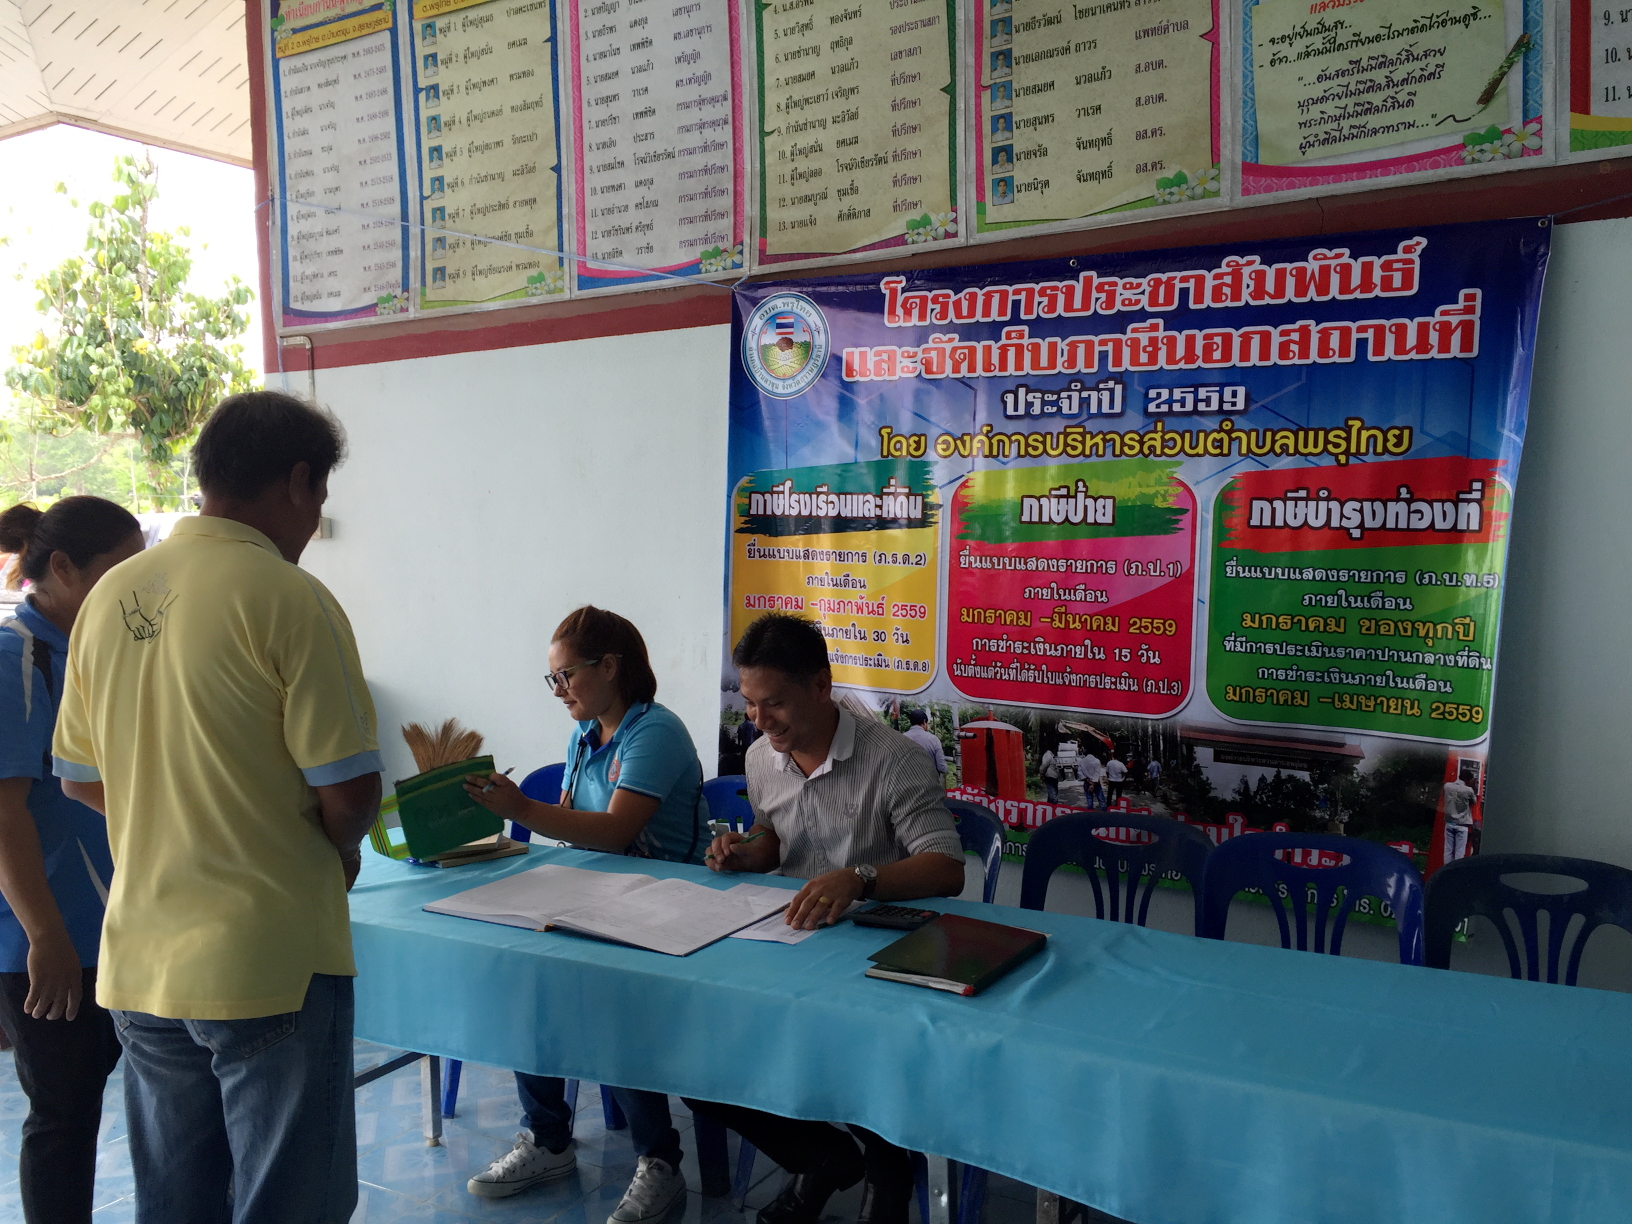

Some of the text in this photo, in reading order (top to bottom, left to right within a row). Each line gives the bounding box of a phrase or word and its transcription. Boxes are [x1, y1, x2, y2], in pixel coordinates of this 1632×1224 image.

[1604, 9, 1614, 26] 9.
[291, 41, 294, 49] 2
[774, 30, 781, 39] 5.
[775, 53, 781, 64] 6.
[1605, 47, 1621, 64] 10.
[776, 78, 782, 88] 7.
[1014, 80, 1055, 98] นายสมยศ
[1605, 86, 1621, 102] 11.
[776, 102, 783, 112] 8.
[778, 150, 787, 161] 10.
[461, 177, 464, 186] 6
[778, 174, 787, 185] 11.
[778, 197, 787, 208] 12.
[778, 221, 787, 232] 13.
[462, 270, 466, 279] 9
[881, 238, 1427, 327] โครงการประชาสัมพันธ์
[843, 289, 1481, 381] และจัดเก็บภาษีนอกสถานที่
[1003, 382, 1246, 416] ประจำปี 2559
[880, 420, 1410, 464] โดย องค์การบริหารส่วนตำบลพรุไทย
[750, 478, 924, 519] ภาษีโรงเรือนและที่ดิน
[1021, 480, 1114, 524] ภาษีป้าย
[1250, 481, 1483, 538] ภาษีบำรุงท้องที่
[747, 538, 927, 567] ยื่นแบบแสดงรายการ (ภ.ร.ด.2)
[960, 546, 1182, 578] ยื่นแบบแสดงรายการ (ภ.ป.1)
[806, 572, 867, 590] ภายในเดือน
[1226, 557, 1499, 589] ยื่นแบบแสดงรายการ (ภ.บ.ท.5)
[1024, 582, 1108, 603] ภายในเดือน
[1302, 590, 1413, 610] ภายในเดือน
[745, 595, 804, 610] มกราคม
[892, 604, 927, 619] 2559
[961, 607, 1031, 627] มกราคม
[1129, 617, 1176, 636] 2559
[1242, 612, 1476, 647] มกราคม ของทุกปี
[873, 630, 886, 643] 30
[892, 627, 910, 645] วัน
[973, 634, 1161, 664] การชำระเงินภายใน 15 วัน
[1224, 633, 1492, 670] ที่มีการประเมินราคาปานกลางที่ดิน
[828, 648, 930, 673] แจ้งการประเมิน (ภ.ร.ด.8)
[953, 654, 1182, 696] นับตั้งแต่วันที่ได้รับใบแจ้งการประเมิน (ภ.ป.3)
[1258, 666, 1452, 693] การชำระเงินภายในเดือน
[1225, 685, 1308, 706] มกราคม
[1430, 702, 1484, 723] 2559
